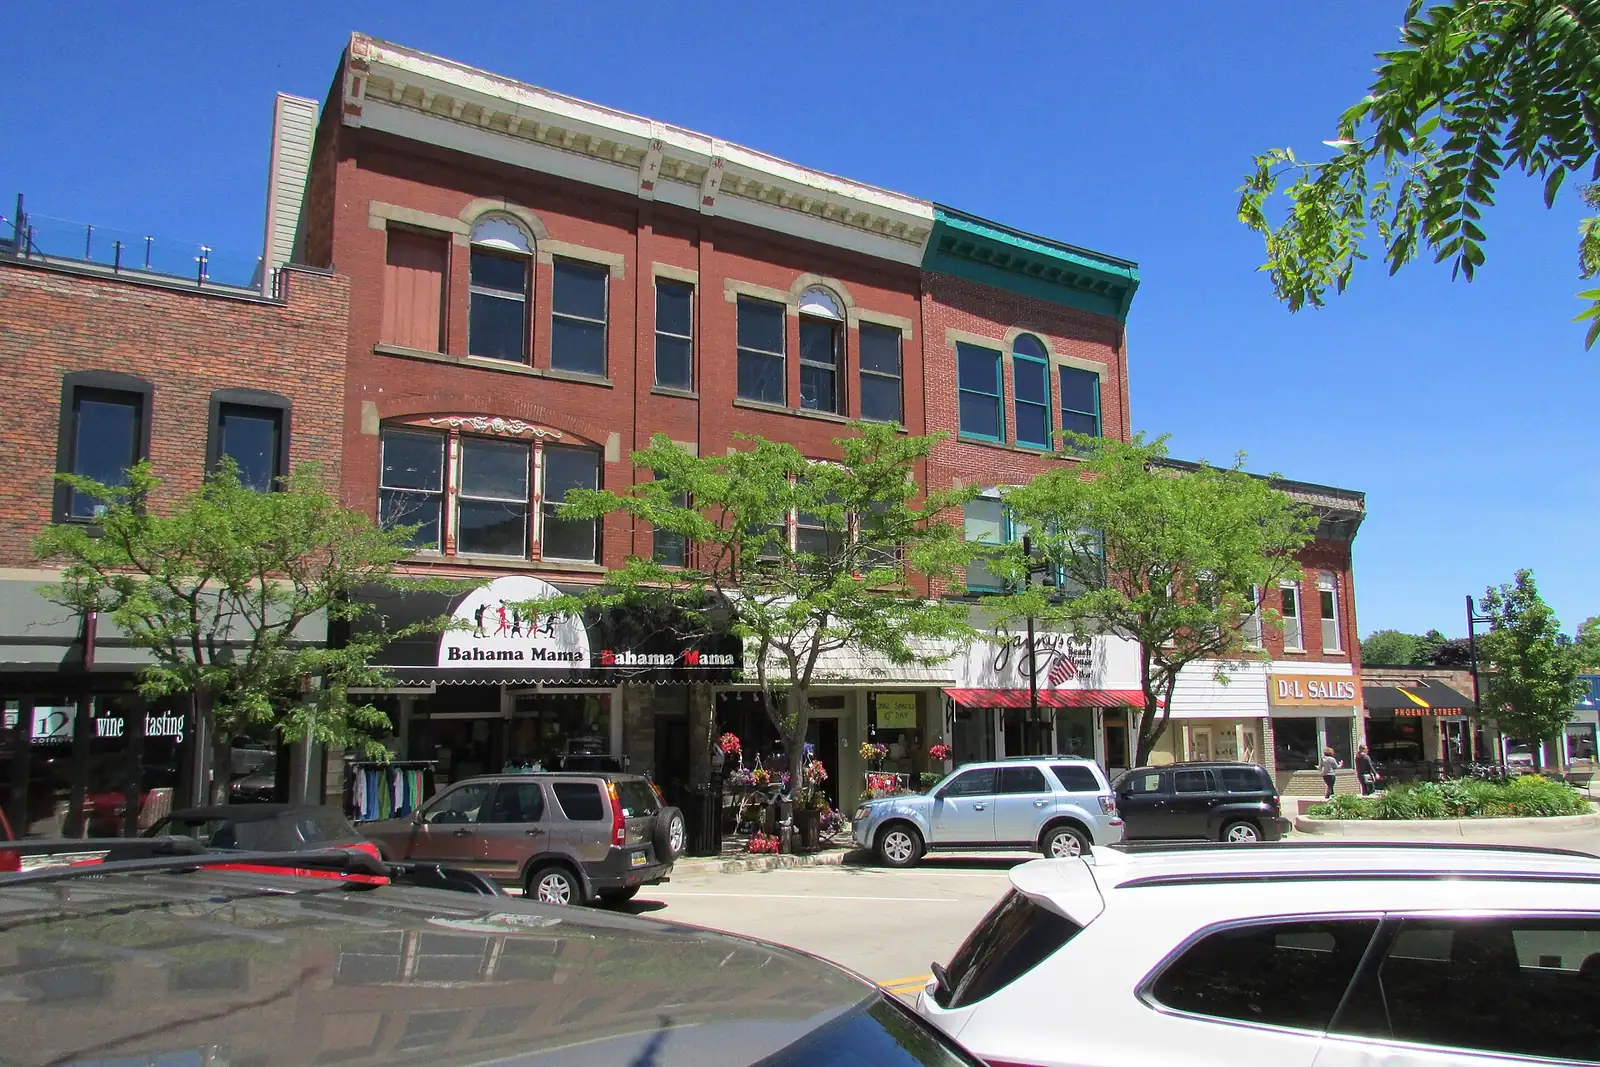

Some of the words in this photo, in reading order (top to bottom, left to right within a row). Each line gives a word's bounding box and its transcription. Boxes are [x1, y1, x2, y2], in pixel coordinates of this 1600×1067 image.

[448, 647, 524, 661] Bahama
[531, 647, 584, 662] Mama
[601, 650, 675, 665] Bahama
[684, 650, 735, 665] Mama
[1278, 680, 1303, 699] D&L
[1308, 681, 1355, 701] SALES
[1394, 708, 1431, 717] PHOENIX
[1433, 708, 1462, 716] STREET
[38, 711, 70, 737] 12
[97, 710, 124, 737] wine
[144, 709, 185, 743] tasting
